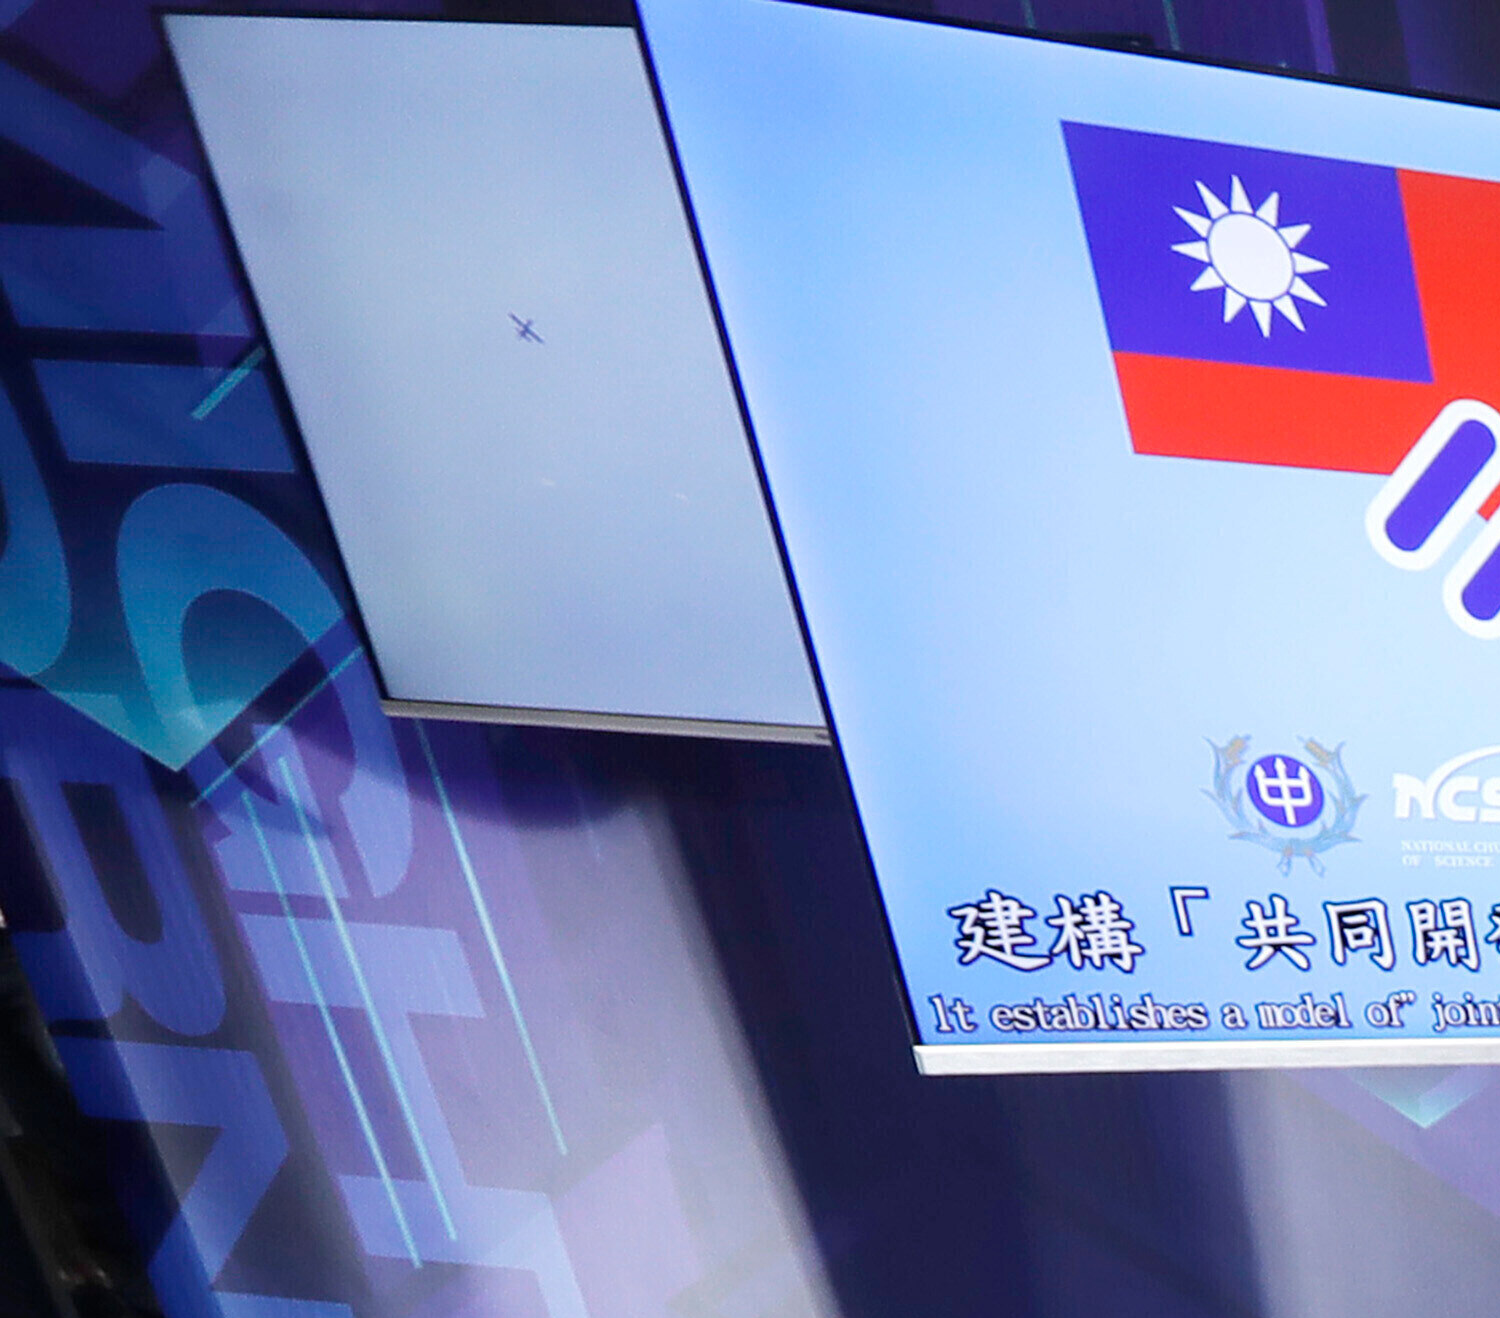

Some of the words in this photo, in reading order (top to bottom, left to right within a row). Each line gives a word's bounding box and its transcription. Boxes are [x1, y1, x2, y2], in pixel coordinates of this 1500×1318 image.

[1401, 839, 1469, 852] NATIONAL
[1402, 855, 1422, 867] OF
[1434, 855, 1496, 868] SCIENCE
[990, 992, 1210, 1033] establishes
[1222, 1004, 1248, 1029] a
[1257, 992, 1353, 1030] model
